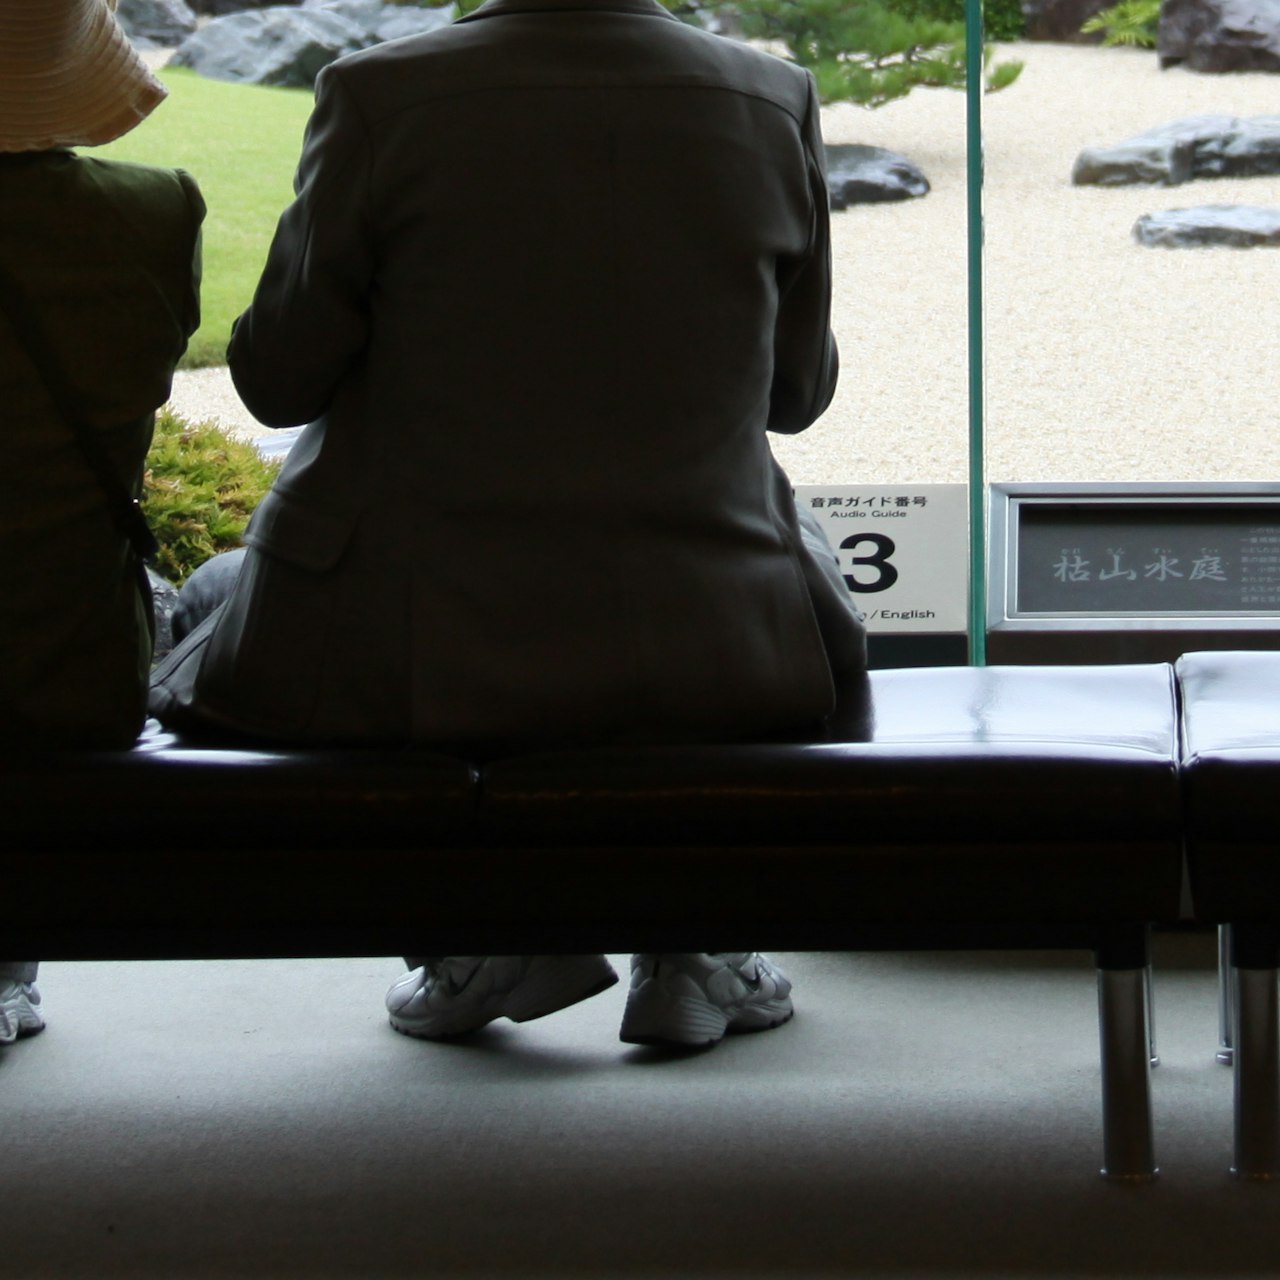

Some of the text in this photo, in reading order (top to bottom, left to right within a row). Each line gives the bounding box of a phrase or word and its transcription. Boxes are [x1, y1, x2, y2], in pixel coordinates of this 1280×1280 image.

[810, 496, 928, 508] 音声ガイド番号
[830, 510, 907, 519] Audio Guide
[840, 533, 898, 593] 3
[1052, 553, 1228, 582] 枯山水庭
